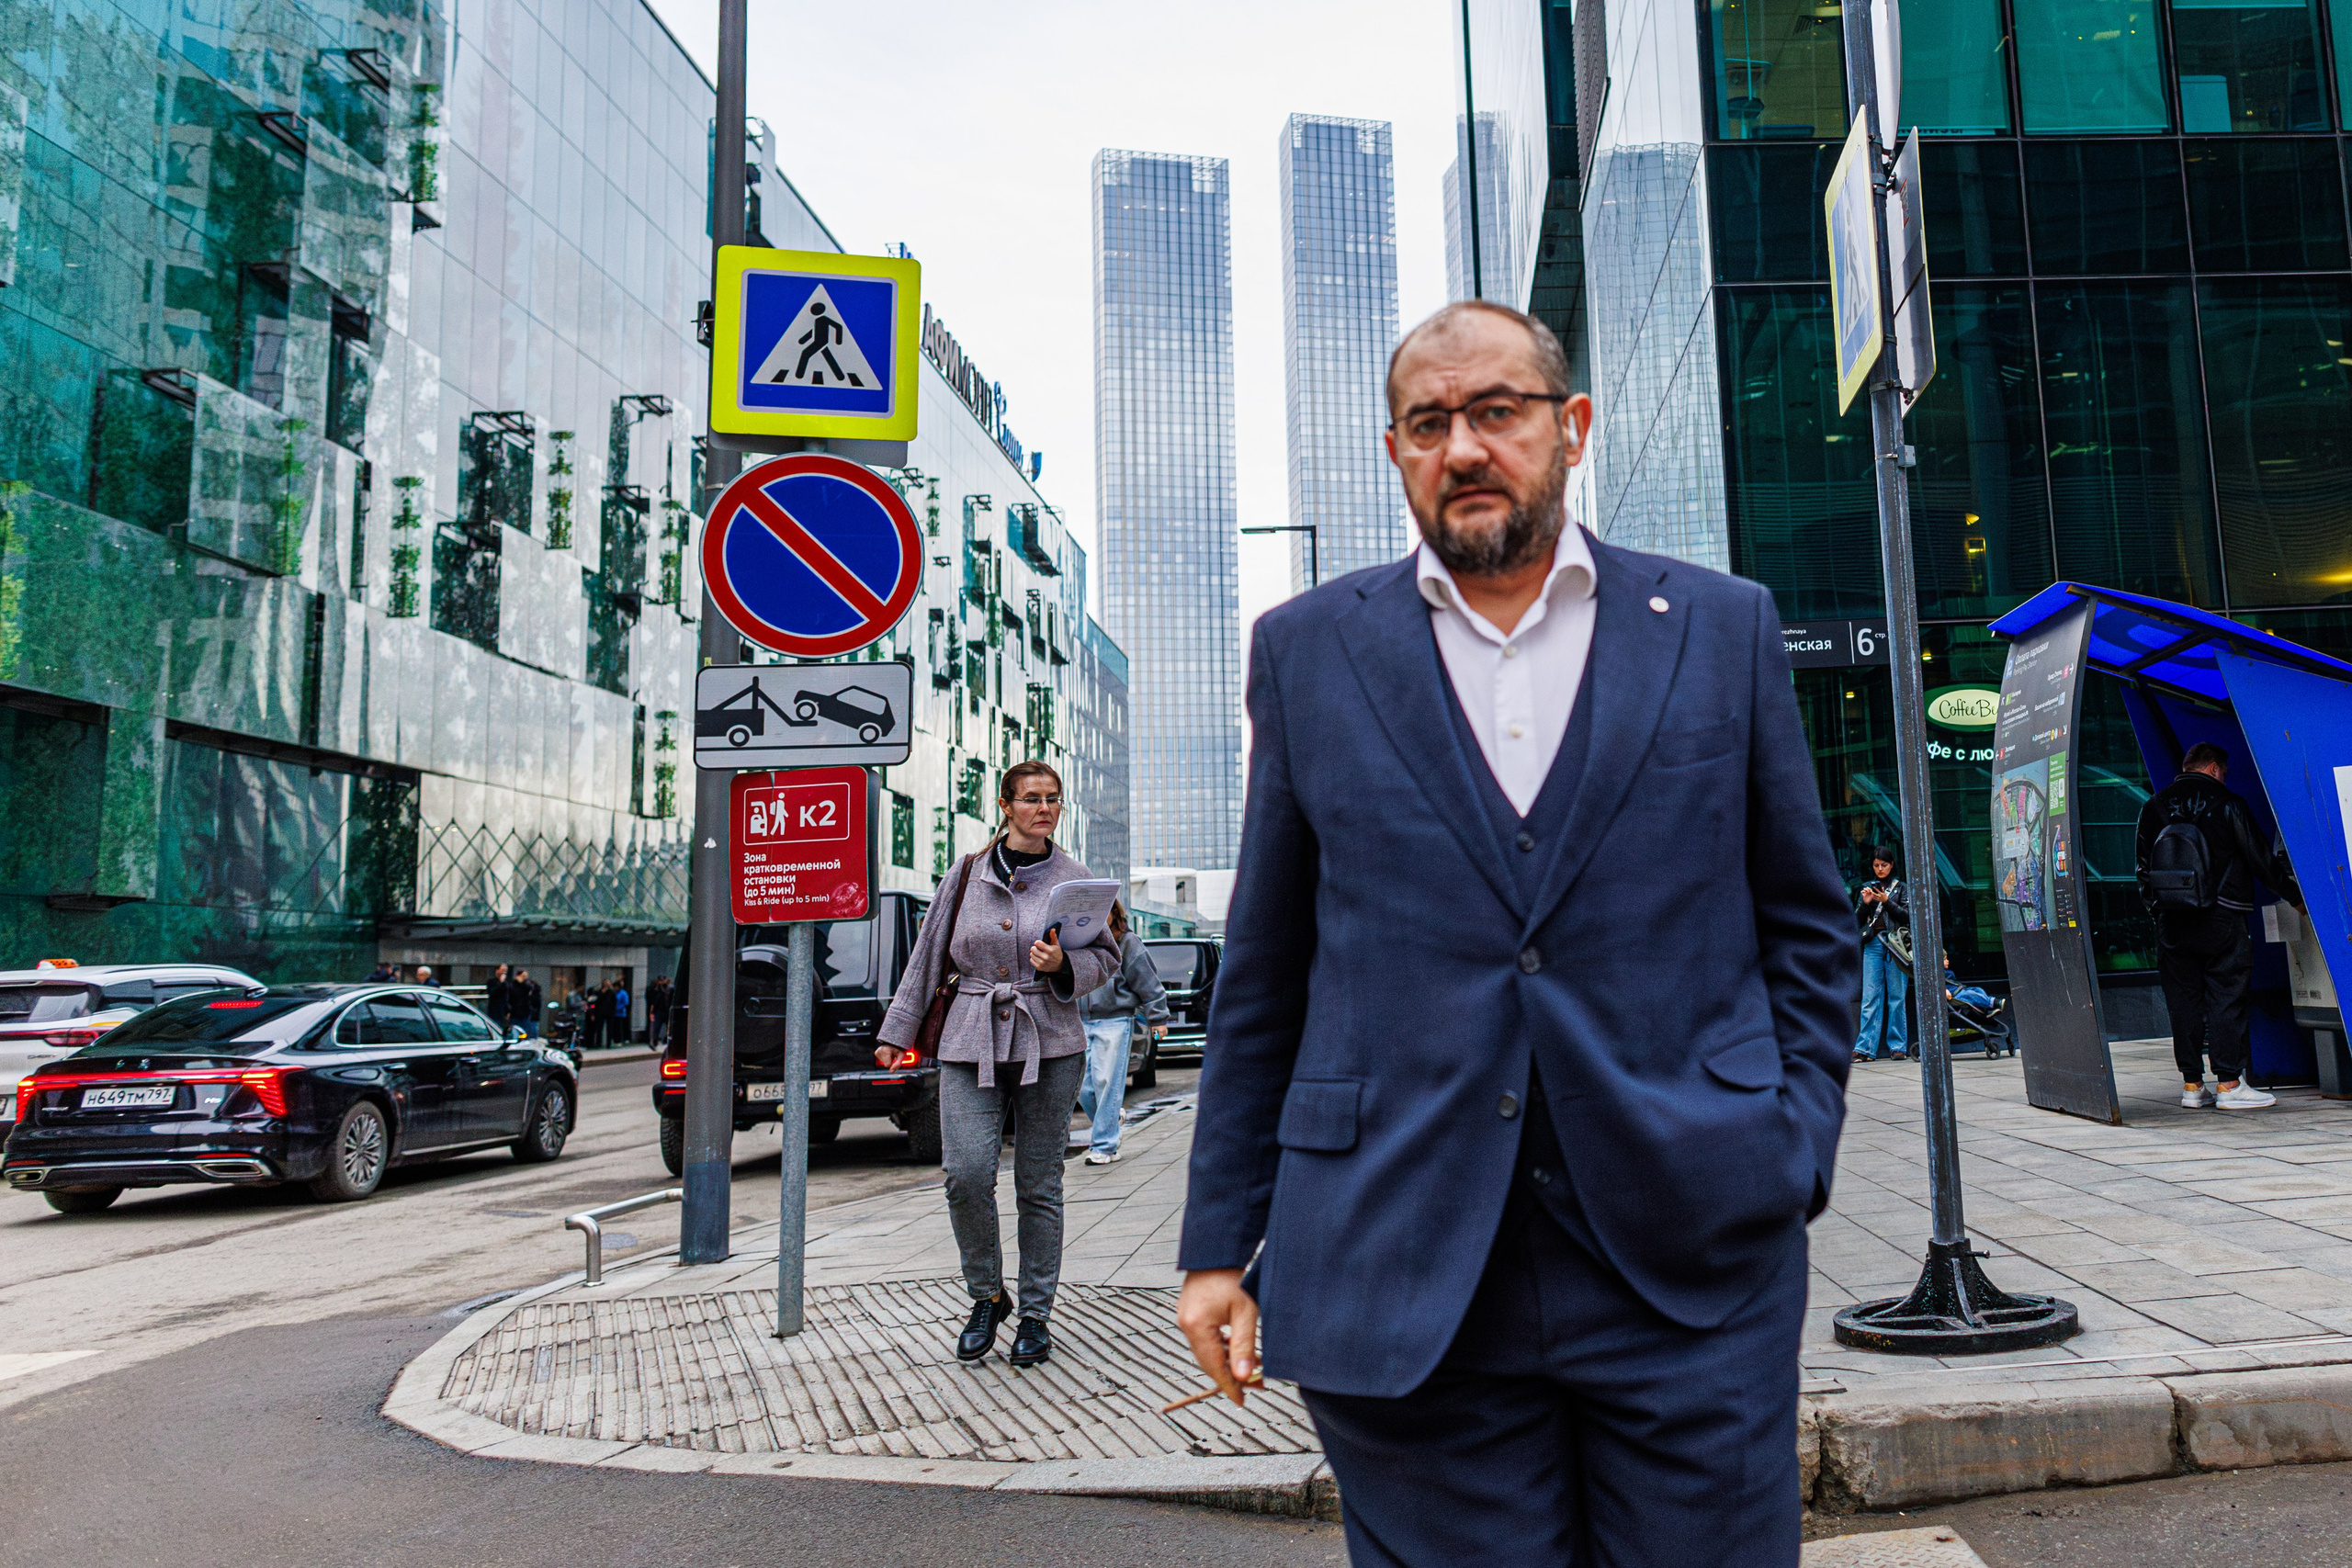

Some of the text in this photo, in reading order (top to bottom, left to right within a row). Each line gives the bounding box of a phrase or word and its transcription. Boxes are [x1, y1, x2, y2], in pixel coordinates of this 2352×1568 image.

[1857, 627, 1875, 656] 6
[1939, 698, 1978, 719] Coffee
[1926, 740, 1951, 759] фе
[1955, 748, 1966, 761] с
[1969, 748, 1995, 761] лю
[743, 852, 767, 863] Зона
[743, 859, 841, 875] кратковременной
[743, 874, 797, 886] остановки
[743, 883, 796, 898] (до 5 мин)
[744, 898, 757, 907] Kiss
[757, 897, 763, 906] &
[763, 897, 780, 905] Ride
[781, 896, 795, 906] (up
[804, 895, 810, 903] 5
[811, 894, 830, 903] min)
[148, 1088, 170, 1100] 797
